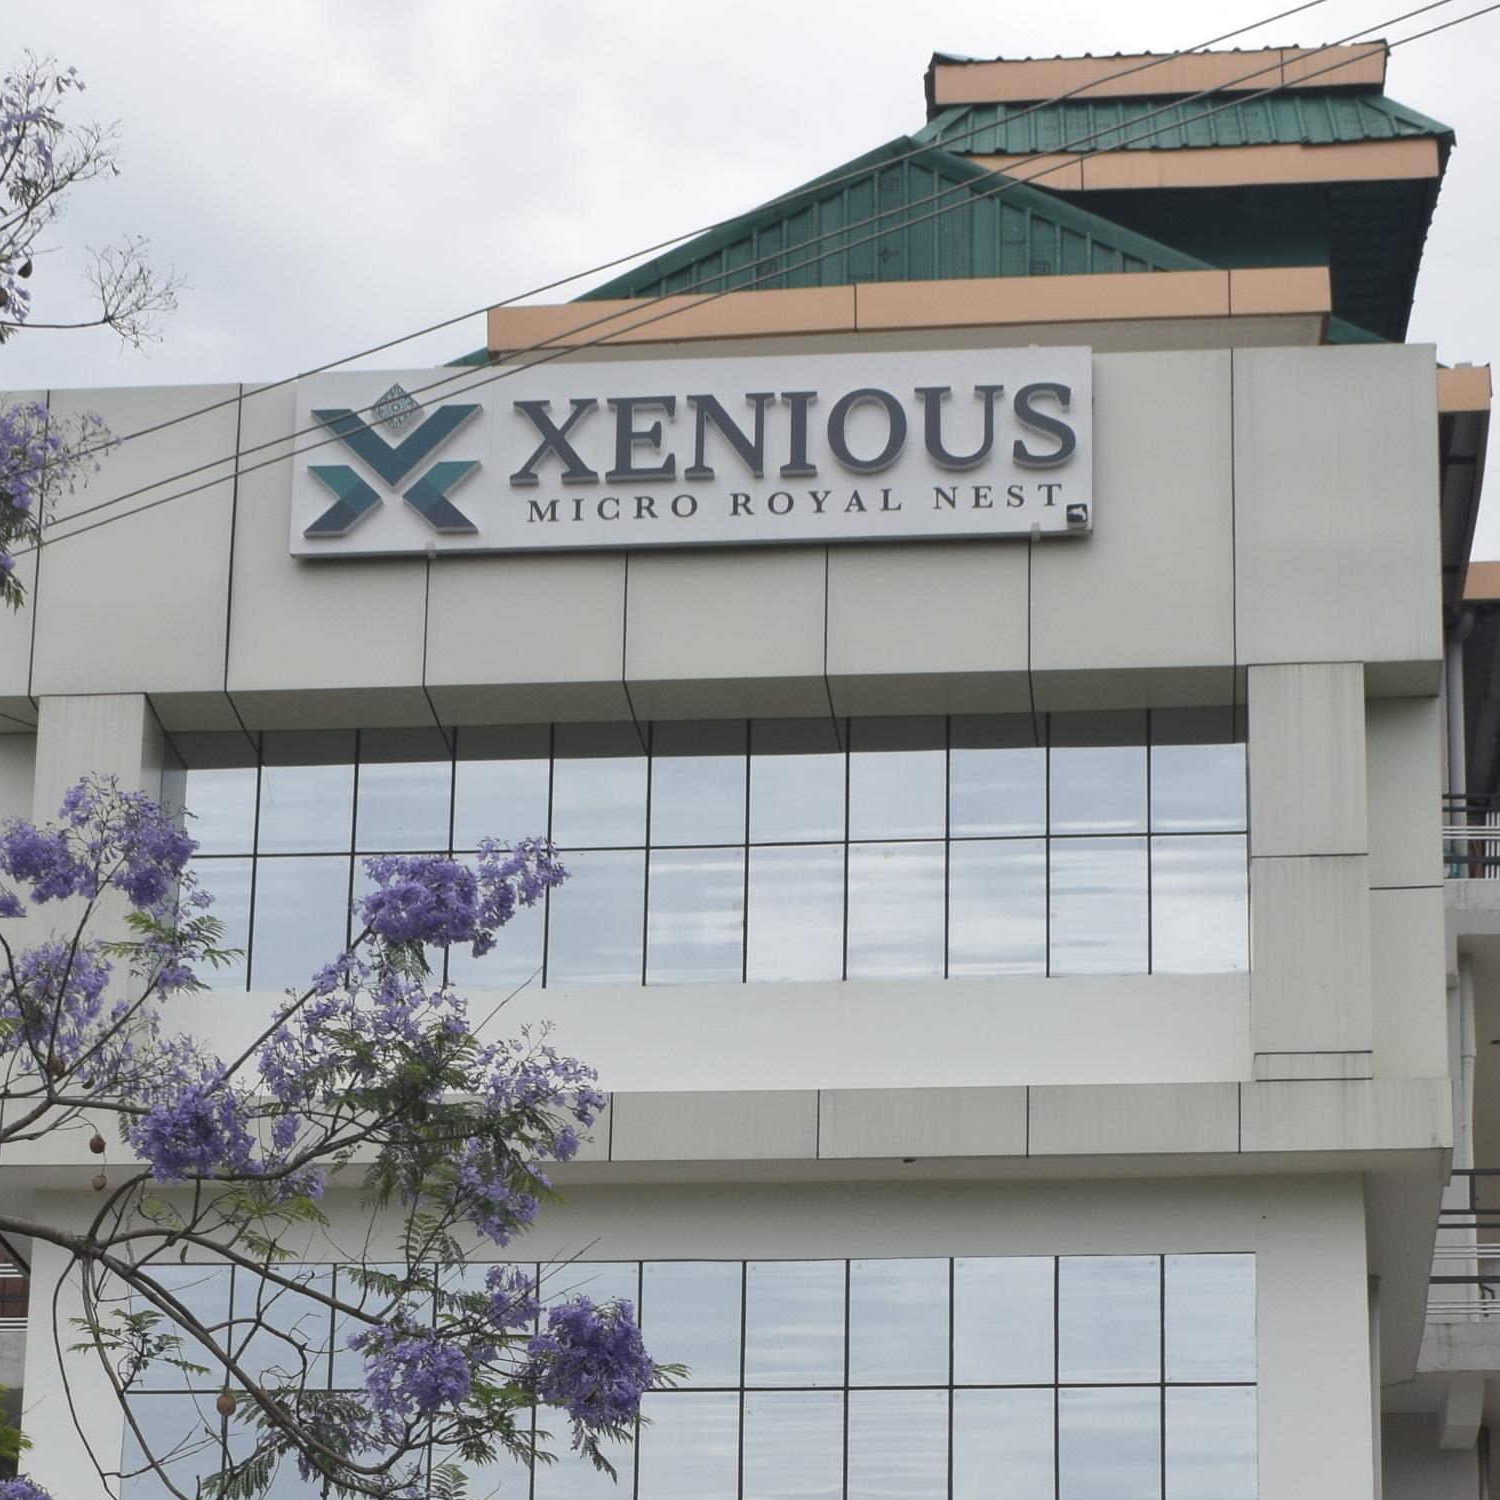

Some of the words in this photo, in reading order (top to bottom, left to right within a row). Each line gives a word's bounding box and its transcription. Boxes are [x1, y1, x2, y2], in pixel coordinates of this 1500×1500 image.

[509, 382, 1077, 487] XENIOUS
[527, 494, 699, 523] MICRO
[730, 488, 902, 516] ROYAL
[933, 483, 1064, 510] NEST
